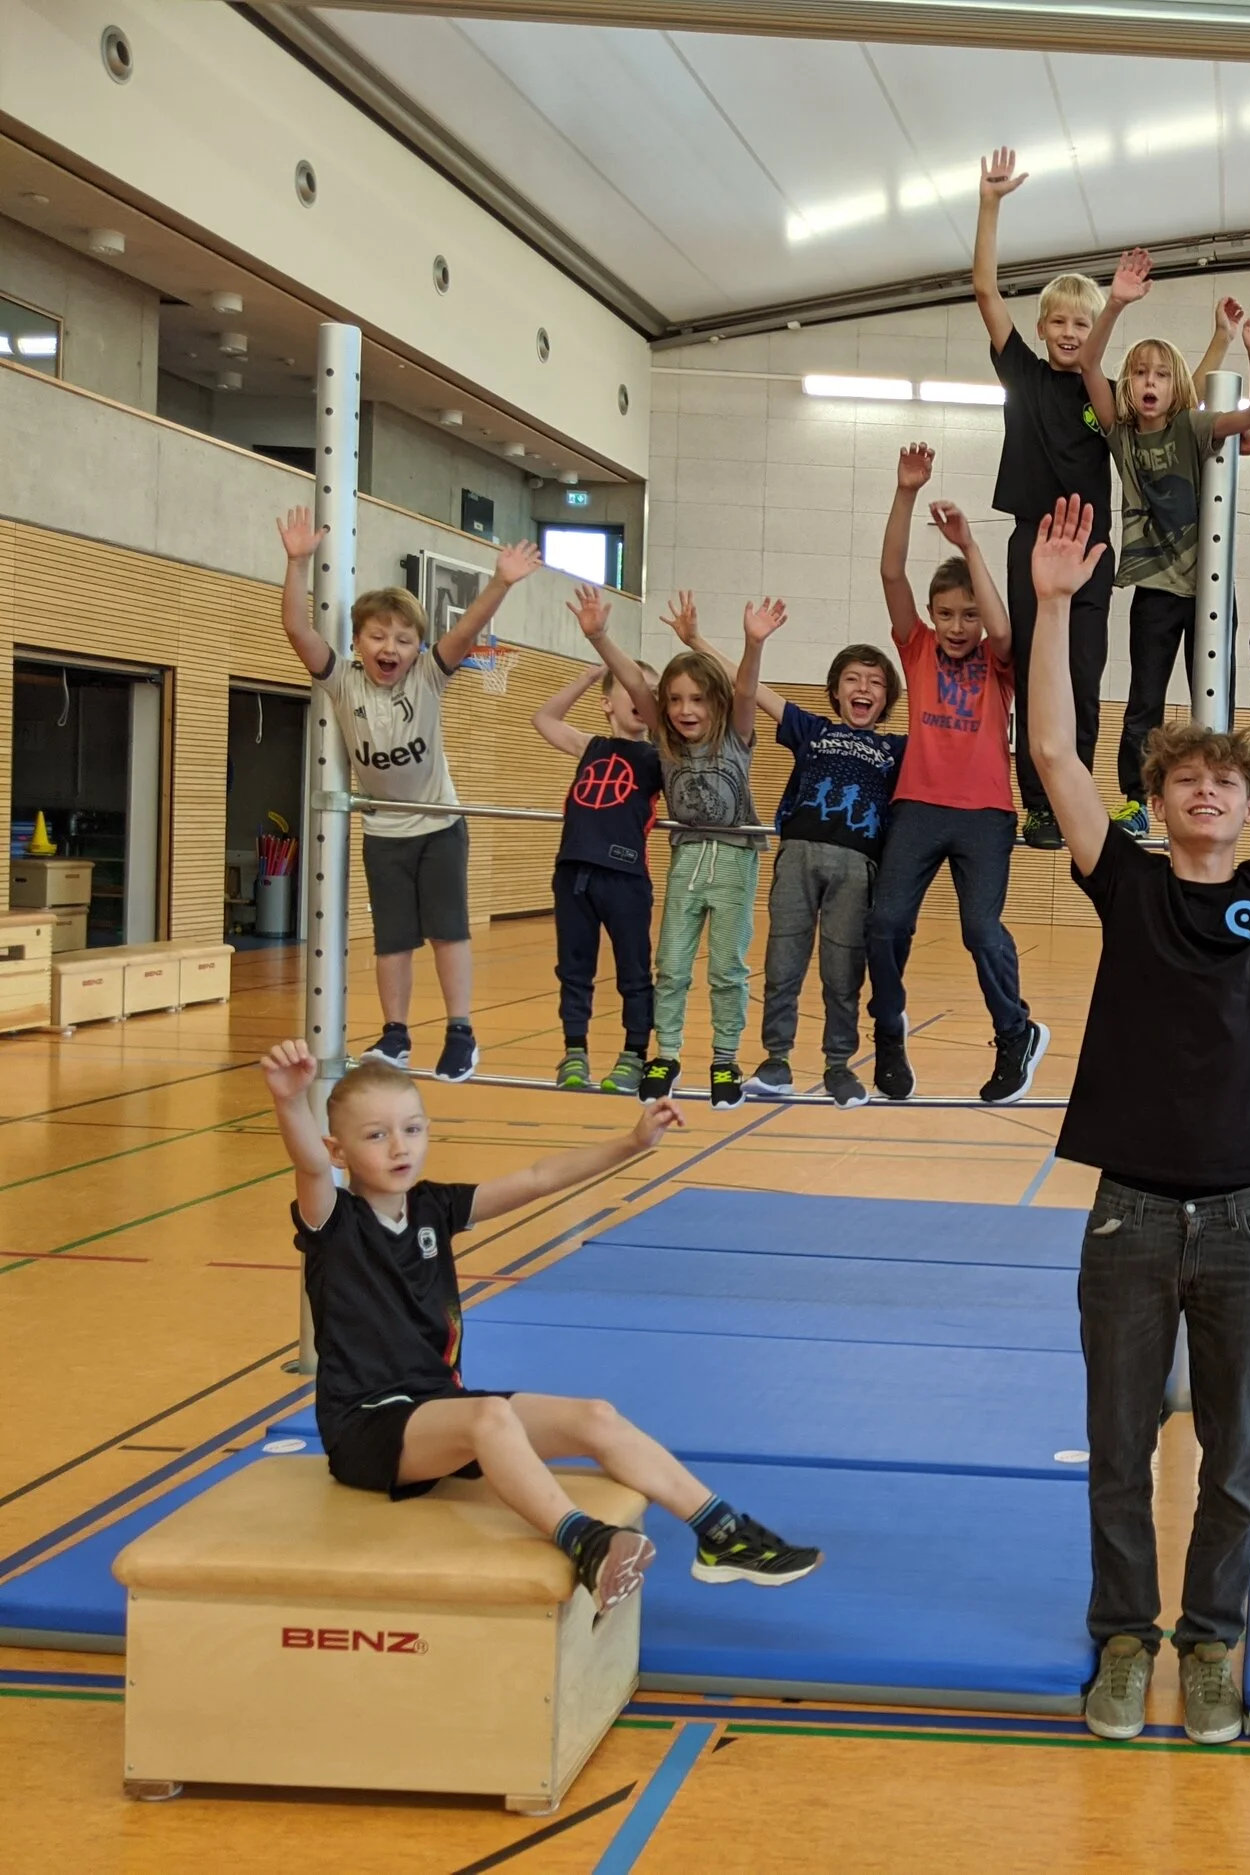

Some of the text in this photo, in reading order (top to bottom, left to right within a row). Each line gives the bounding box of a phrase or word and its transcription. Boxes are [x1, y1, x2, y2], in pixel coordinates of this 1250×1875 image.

[355, 736, 427, 770] Jeep
[818, 748, 875, 766] marathon
[282, 1627, 420, 1653] BENZ
